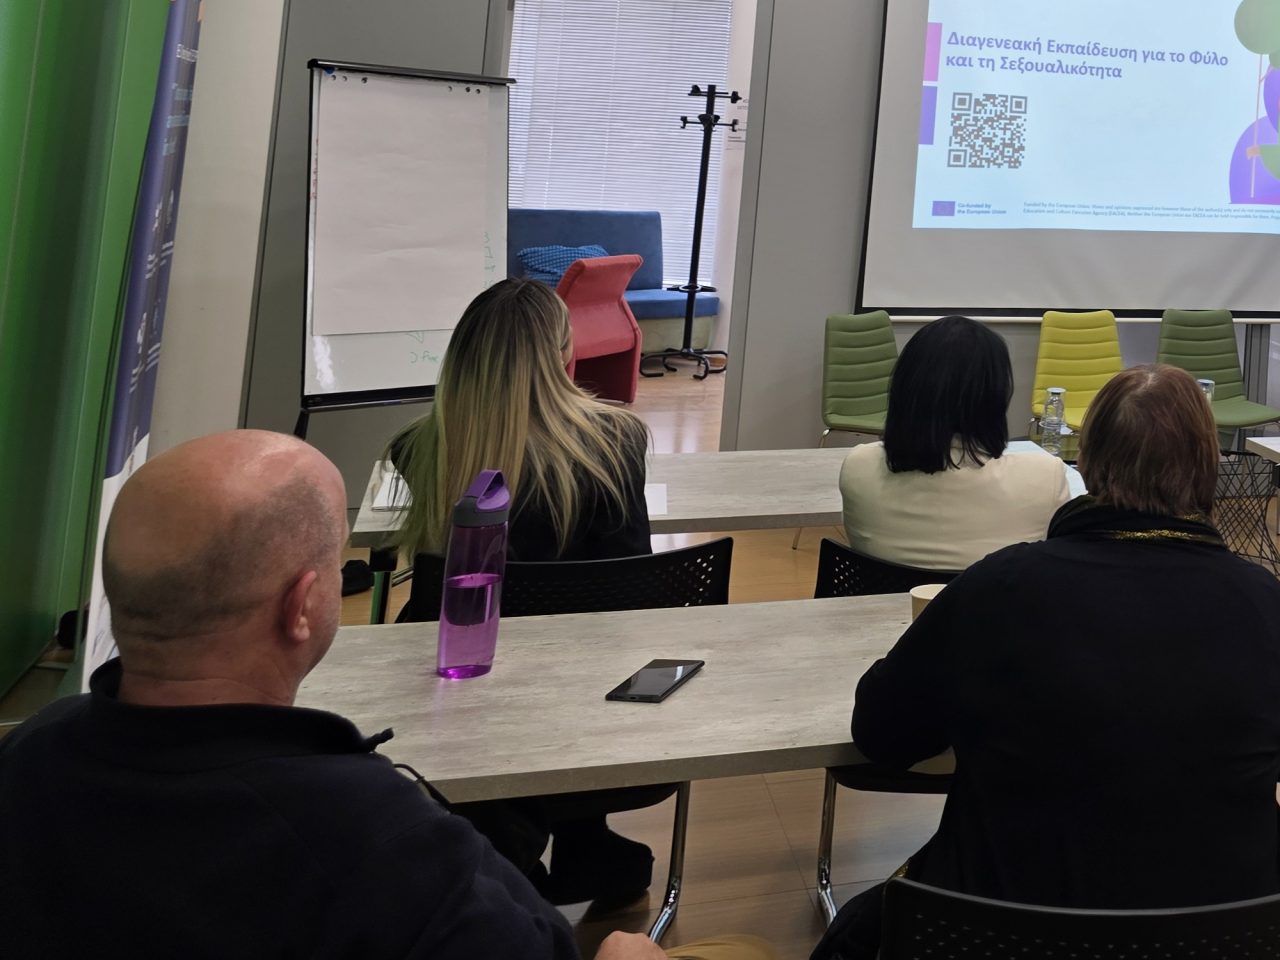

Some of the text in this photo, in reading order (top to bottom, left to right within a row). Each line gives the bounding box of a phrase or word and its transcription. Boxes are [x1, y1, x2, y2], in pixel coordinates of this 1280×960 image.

[947, 31, 1229, 66] Διαγενεακή Εκπαίδευση για το Φύλο
[946, 55, 1122, 79] και τη Σεξουαλικότητα
